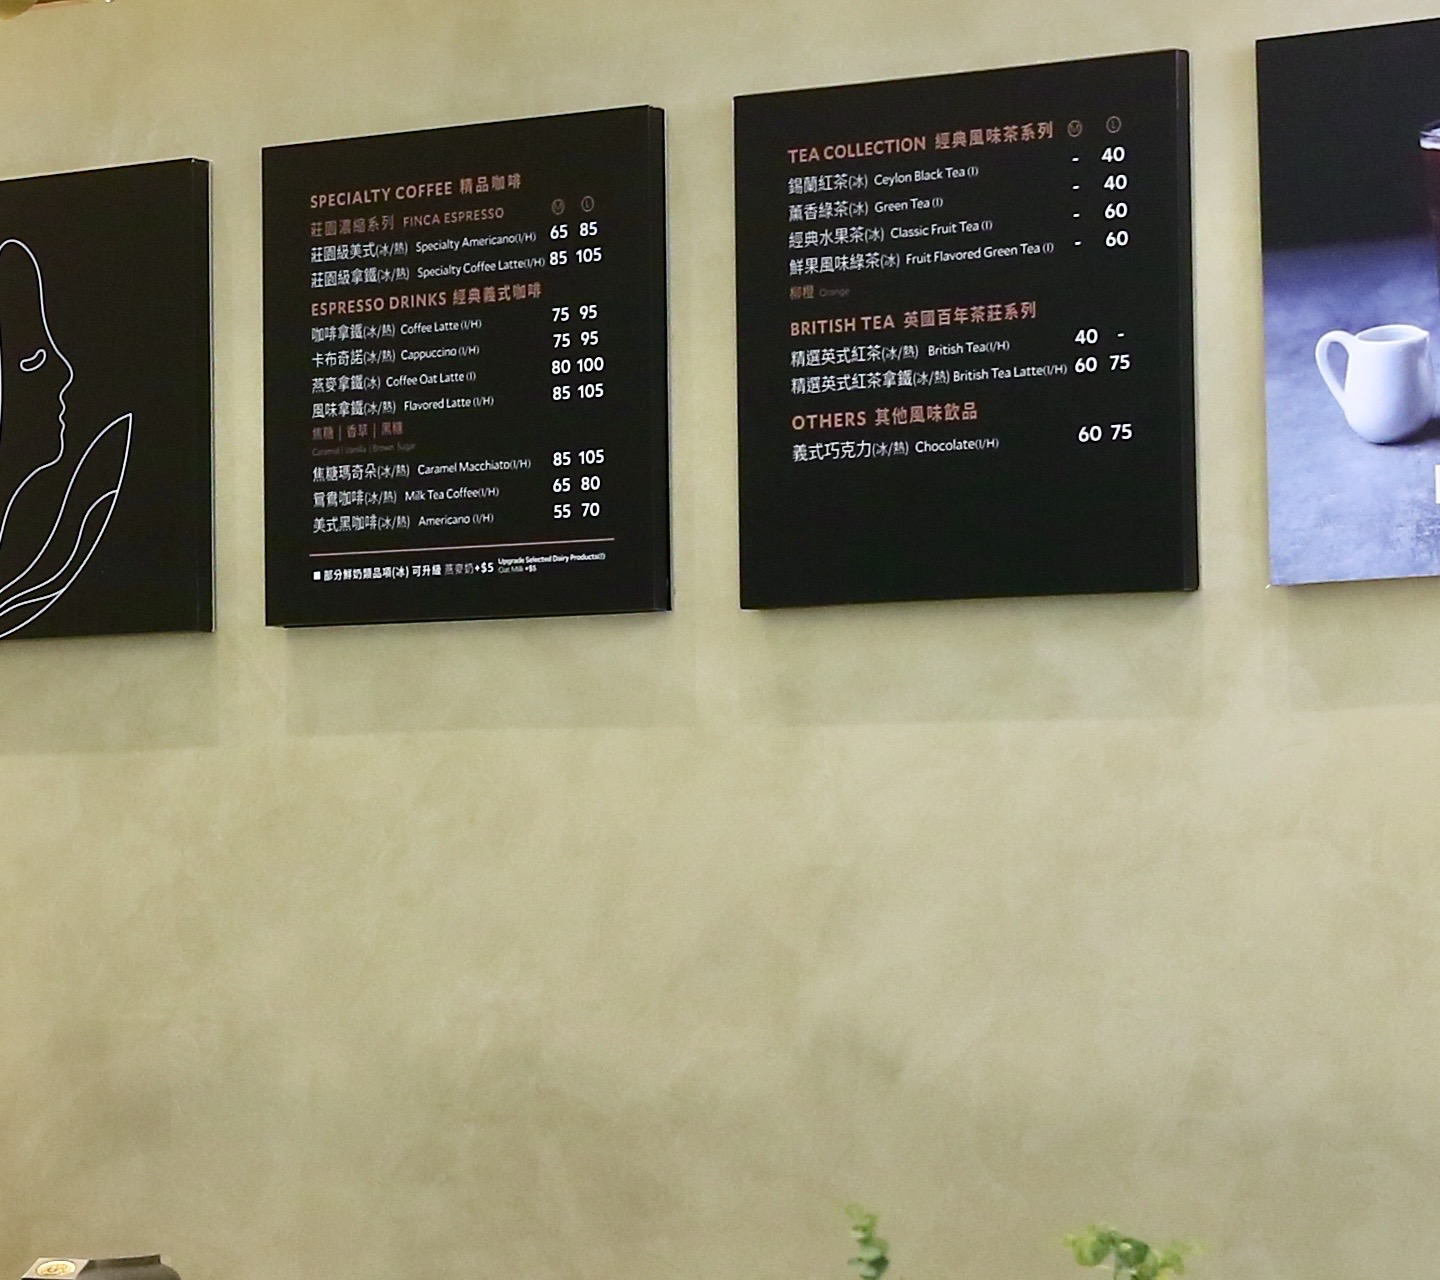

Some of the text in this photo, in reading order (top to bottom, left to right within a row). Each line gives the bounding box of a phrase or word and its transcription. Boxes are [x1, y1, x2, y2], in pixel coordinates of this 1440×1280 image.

[787, 121, 1054, 164] TEA COLLECTION 經典風味茶系列
[874, 171, 912, 187] Ceylon
[914, 169, 943, 182] Black
[945, 167, 966, 178] Tea
[1101, 146, 1125, 162] 40
[310, 173, 521, 208] SPECIALTY COFFEE 精品咖啡
[874, 200, 908, 213] Green
[910, 198, 930, 210] Tea
[1103, 174, 1128, 190] 40
[403, 213, 440, 228] FINCA
[444, 207, 504, 223] ESPRESSO
[890, 225, 929, 239] Classic
[931, 223, 957, 236] Fruit
[959, 221, 980, 232] Tea
[1104, 202, 1128, 219] 60
[415, 238, 460, 254] Specialty
[550, 224, 568, 239] 65
[579, 221, 598, 236] 85
[905, 251, 932, 265] Fruit
[934, 247, 981, 262] Flavored
[983, 245, 1018, 258] Green
[1020, 243, 1041, 255] Tea
[1105, 230, 1129, 247] 60
[417, 263, 462, 279] Specialty
[463, 261, 496, 274] Coffee
[549, 251, 568, 265] 85
[575, 247, 602, 263] 105
[311, 282, 542, 316] ESPRESSO DRINKS 經典義式咖啡
[400, 322, 432, 335] Coffee
[434, 321, 459, 332] Latte
[552, 307, 569, 322] 75
[579, 304, 598, 319] 95
[790, 300, 1036, 336] BRITISH TEA 英國百年茶莊系列
[400, 347, 457, 361] Cappuccino
[553, 333, 570, 348] 75
[580, 330, 599, 346] 95
[928, 343, 963, 357] British
[1074, 328, 1098, 344] 40
[385, 375, 418, 387] Coffee
[419, 373, 437, 385] Oat
[439, 372, 465, 383] Latte
[551, 359, 570, 374] 80
[576, 357, 604, 372] 100
[953, 369, 989, 382] British
[991, 367, 1012, 379] Tea
[1074, 356, 1098, 372] 60
[1109, 354, 1130, 370] 75
[404, 398, 444, 411] Flavored
[446, 397, 471, 409] Latte
[552, 385, 570, 400] 85
[577, 383, 604, 398] 105
[791, 402, 978, 430] OTHERS 其他風味飲品
[1078, 425, 1102, 442] 60
[1110, 423, 1132, 440] 75
[417, 462, 457, 476] Caramel
[553, 451, 571, 466] 85
[578, 449, 605, 465] 105
[405, 489, 426, 501] Milk
[427, 488, 444, 500] Tea
[553, 478, 571, 493] 65
[581, 476, 600, 491] 80
[418, 515, 471, 527] Americano
[553, 504, 571, 519] 55
[581, 502, 600, 517] 70
